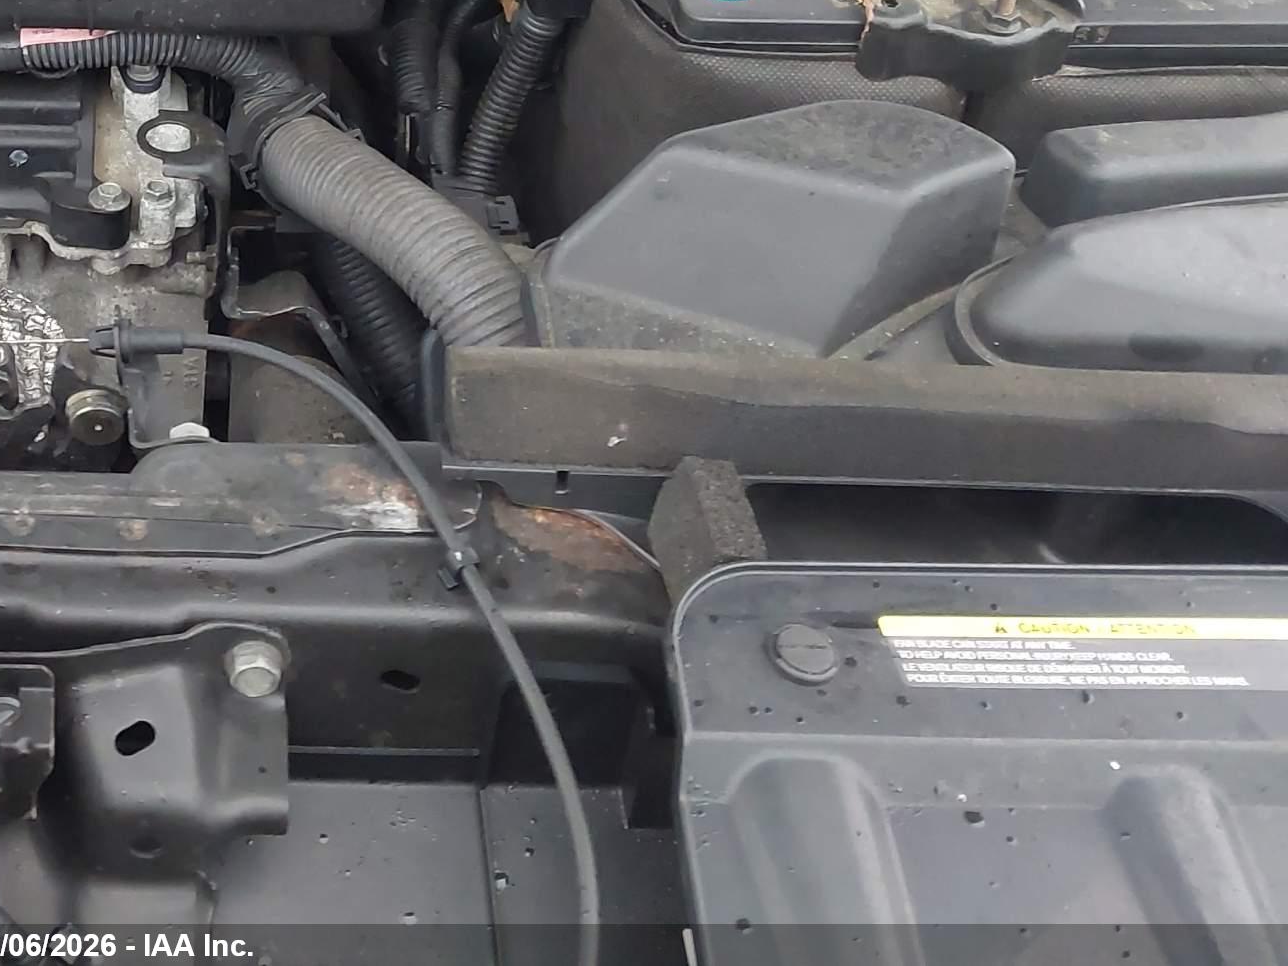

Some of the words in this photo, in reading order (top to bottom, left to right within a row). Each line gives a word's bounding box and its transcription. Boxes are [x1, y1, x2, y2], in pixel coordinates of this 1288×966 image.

[1018, 622, 1090, 634] CAUTION
[914, 650, 944, 659] HELP
[976, 651, 1033, 660] PERSONAL
